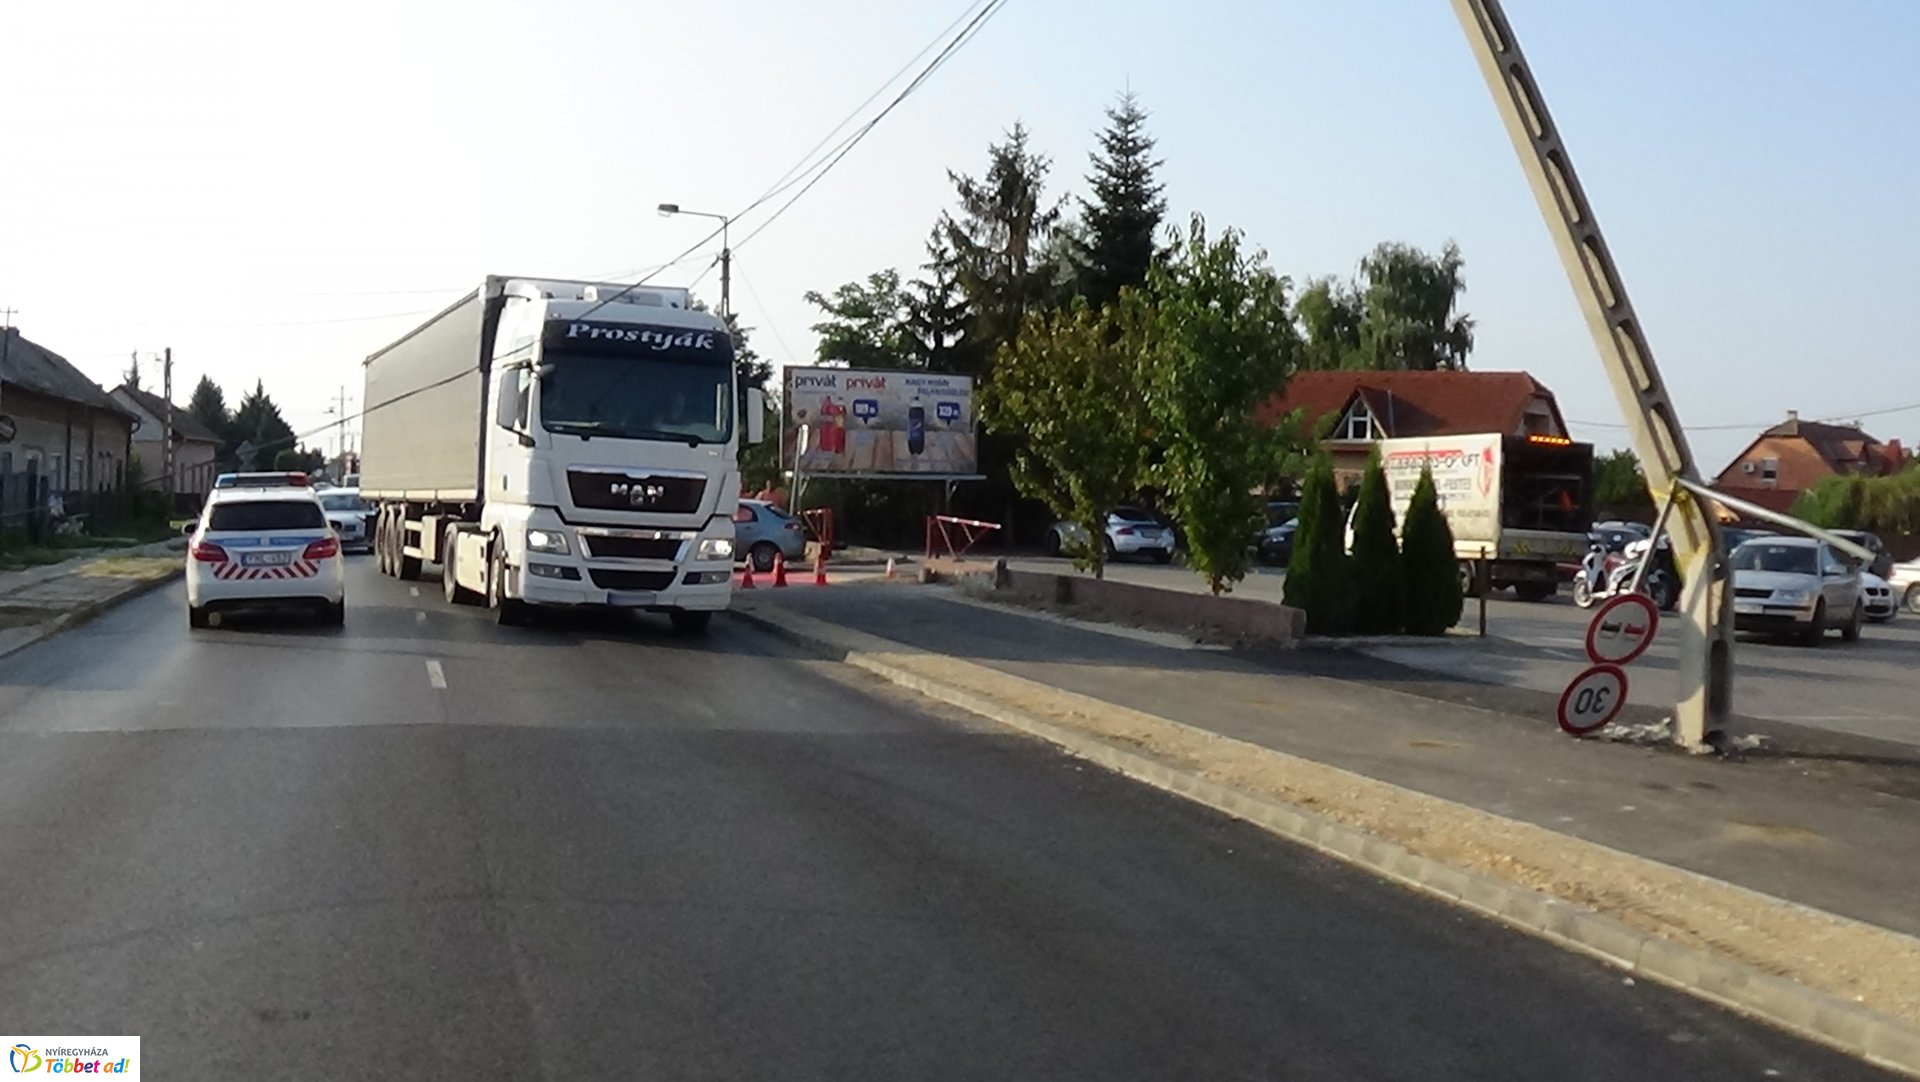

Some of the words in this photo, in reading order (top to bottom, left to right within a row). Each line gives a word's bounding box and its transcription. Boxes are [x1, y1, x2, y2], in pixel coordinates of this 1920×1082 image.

[566, 323, 714, 350] Prostyák
[795, 375, 837, 389] privát
[846, 376, 887, 390] privát
[611, 483, 664, 496] MAN
[1574, 686, 1611, 715] 30
